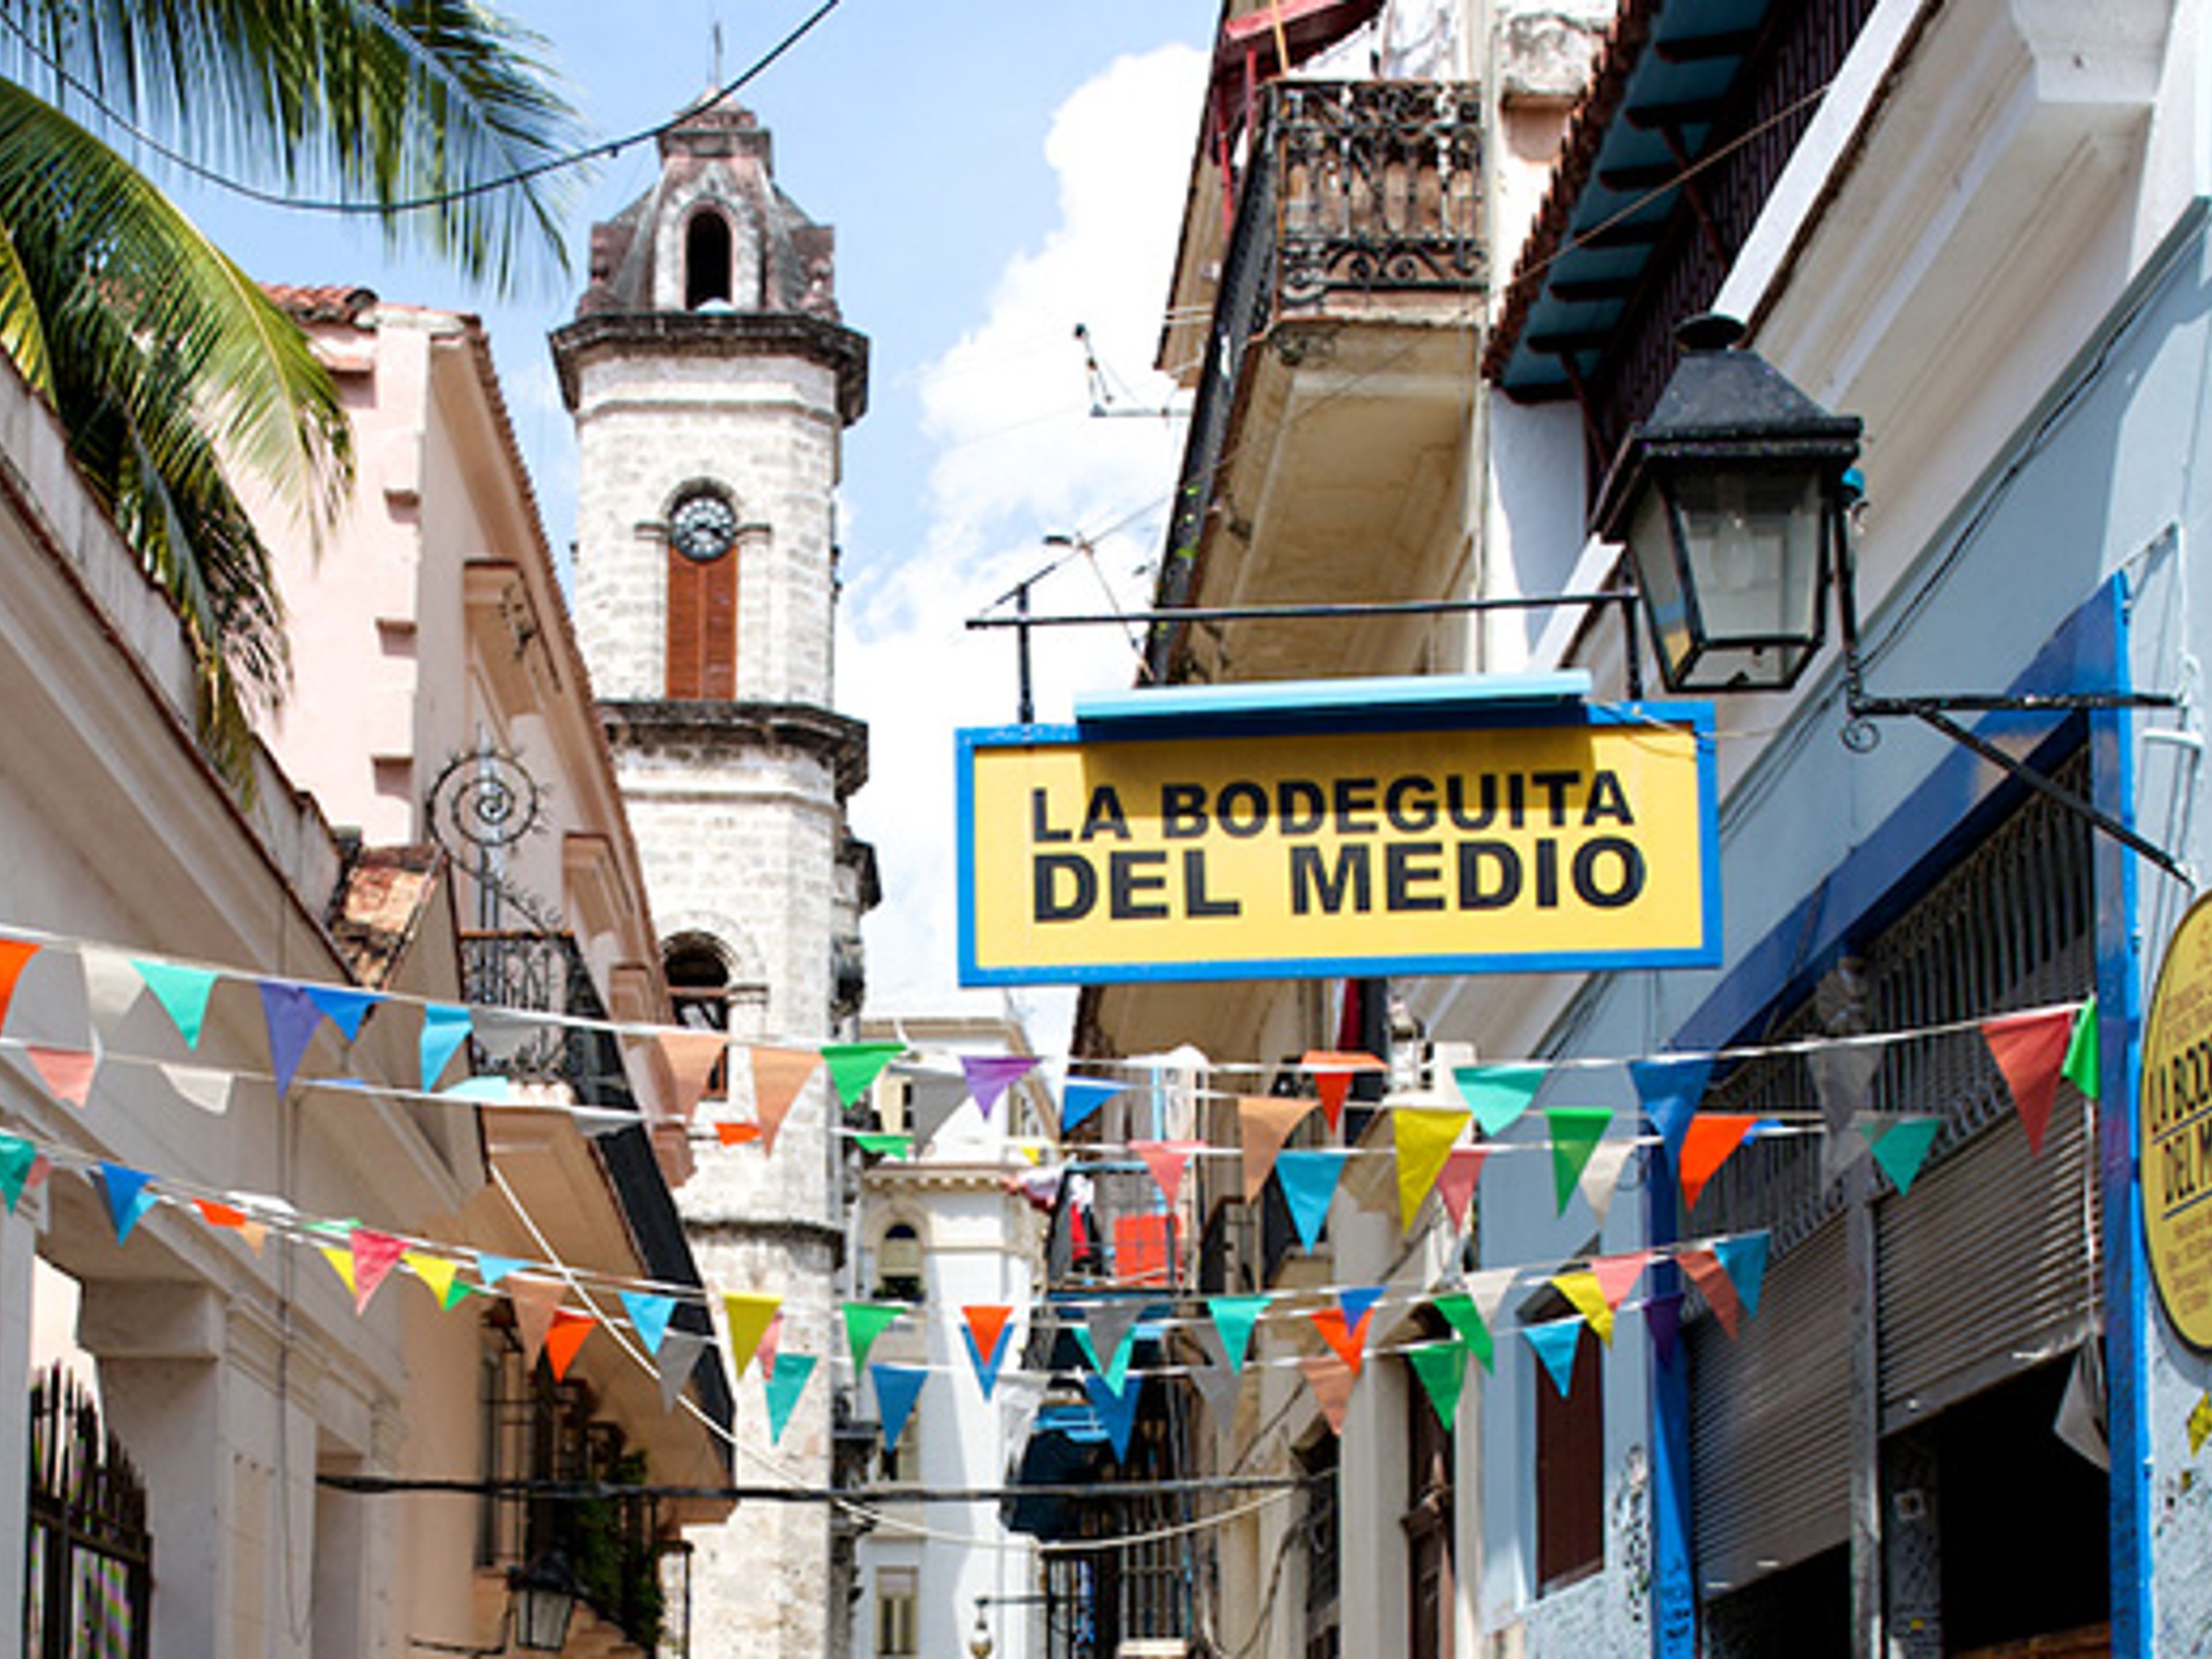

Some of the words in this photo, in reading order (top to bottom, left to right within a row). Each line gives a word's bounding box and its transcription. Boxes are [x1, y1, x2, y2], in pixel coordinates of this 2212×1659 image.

[1034, 786, 1130, 842] LA
[1160, 770, 1635, 838] BODEGUITA
[1034, 850, 1240, 922] DEL
[1290, 837, 1646, 915] MEDIO
